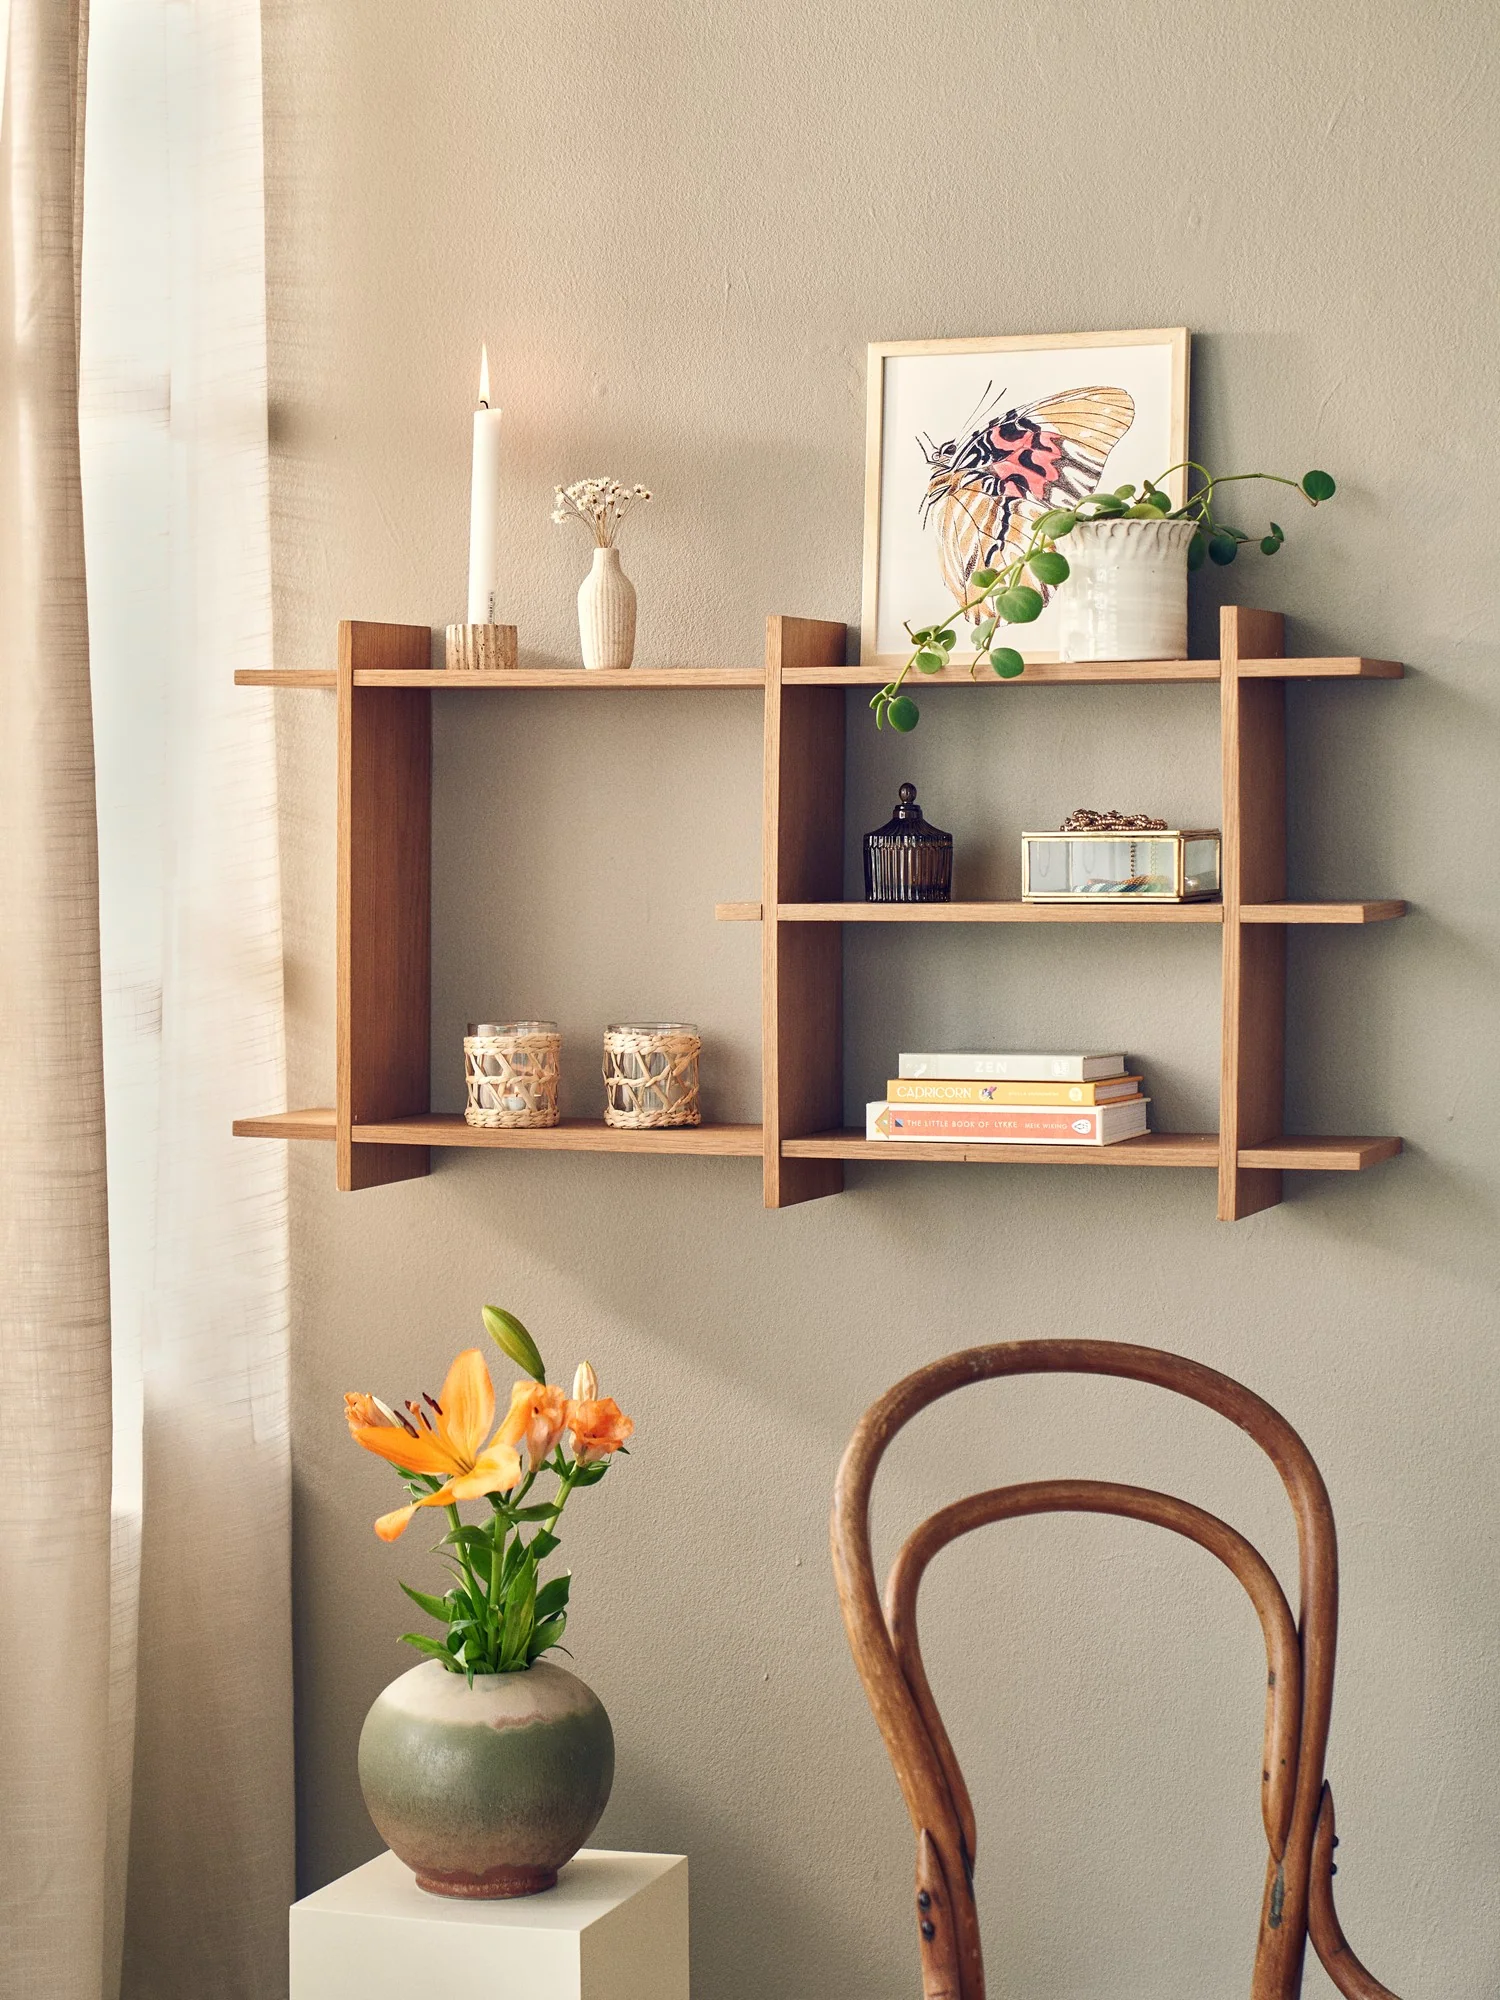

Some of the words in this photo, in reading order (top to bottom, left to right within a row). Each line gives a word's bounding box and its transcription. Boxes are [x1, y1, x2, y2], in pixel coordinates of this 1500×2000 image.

[975, 1062, 1007, 1074] ZEN
[897, 1087, 971, 1099] CAPRICORN
[907, 1119, 921, 1127] THE
[924, 1120, 948, 1128] LITTLE
[952, 1120, 975, 1128] BOOK
[978, 1120, 990, 1128] OF
[994, 1121, 1017, 1129] LYKKE
